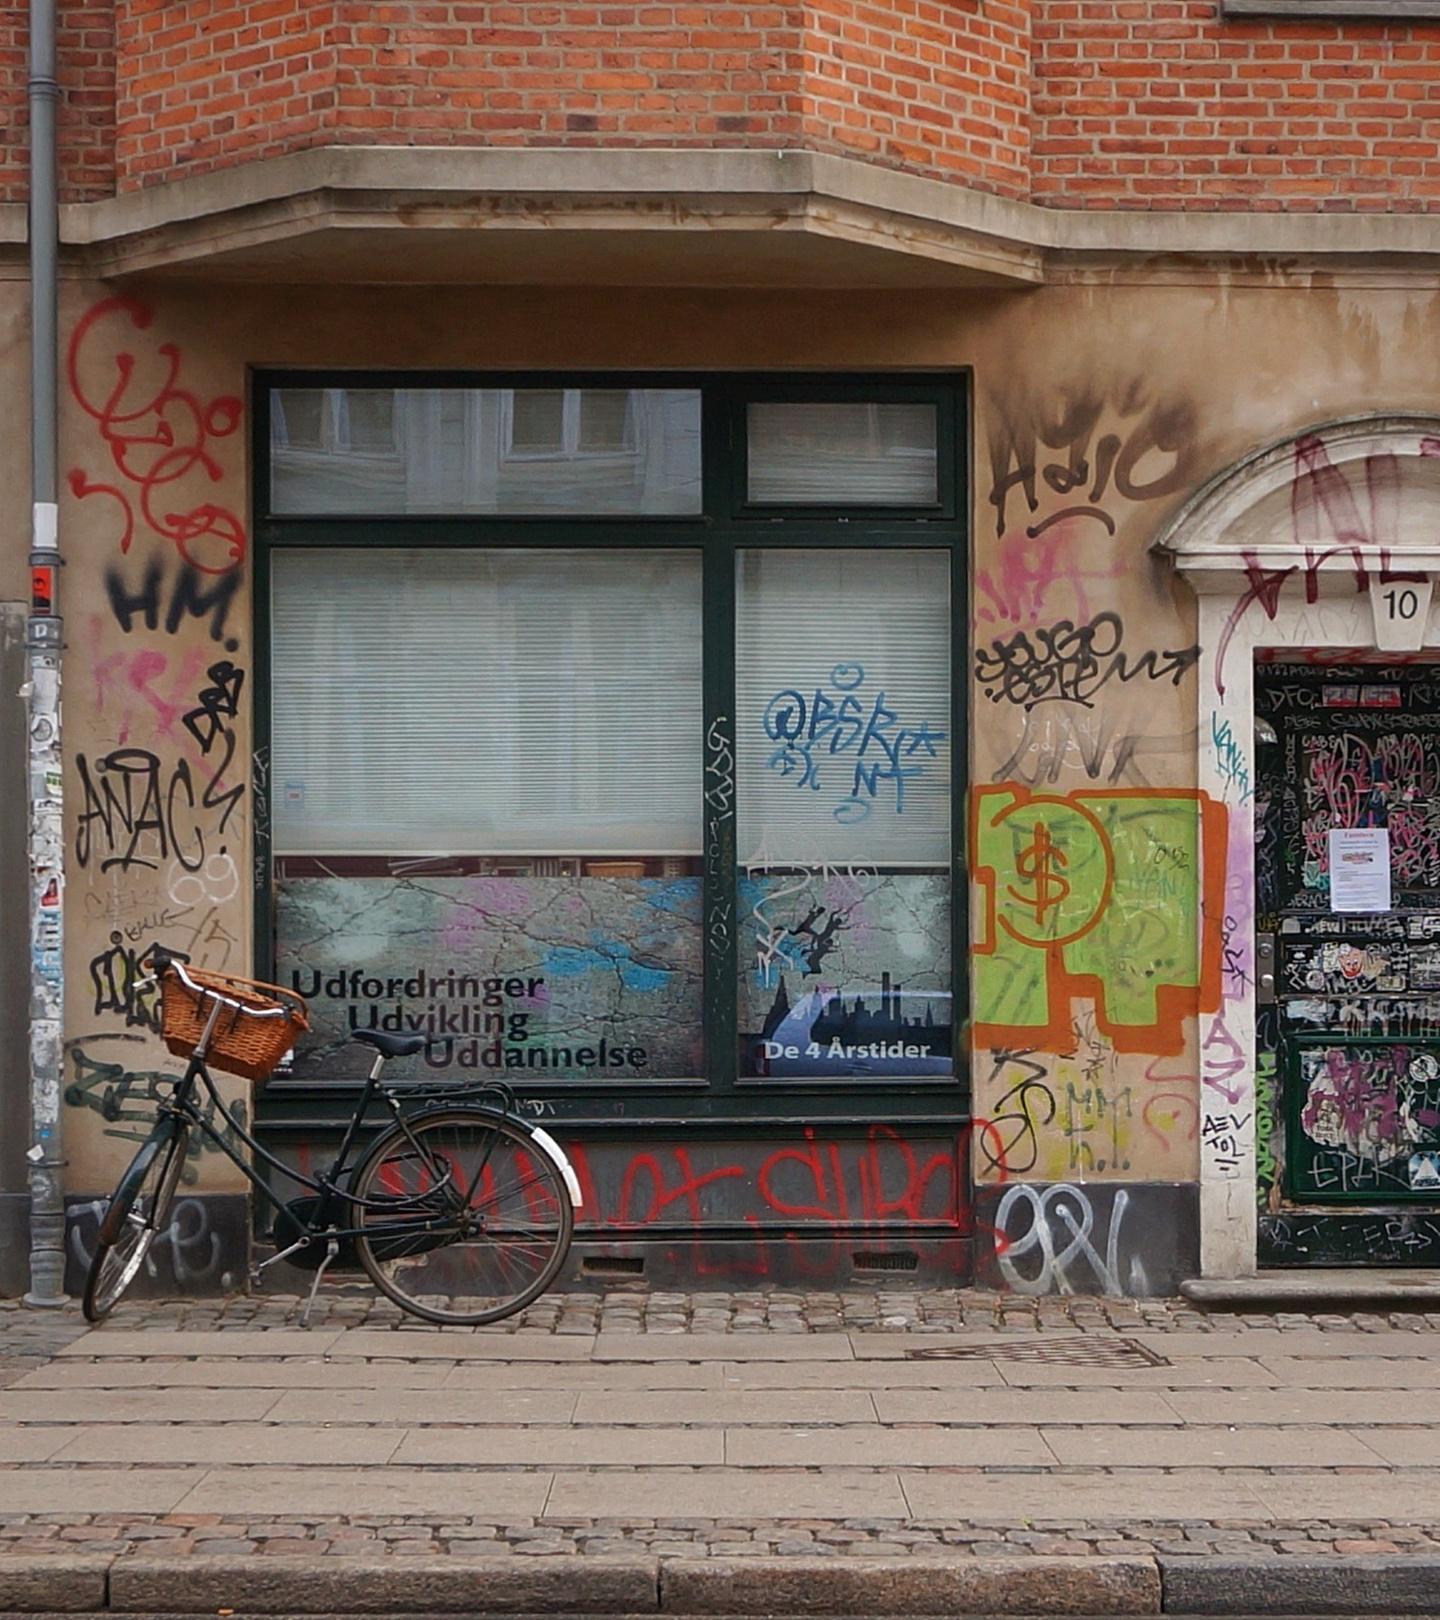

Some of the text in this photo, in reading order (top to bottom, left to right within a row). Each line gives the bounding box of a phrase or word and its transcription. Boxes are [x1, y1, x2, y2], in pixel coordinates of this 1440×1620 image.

[1383, 590, 1418, 620] 10
[292, 969, 545, 1007] Udfordringer
[348, 1004, 530, 1042] Udvikling
[424, 1038, 648, 1069] Uddannelse
[764, 1036, 931, 1060] De 4 Årstider
